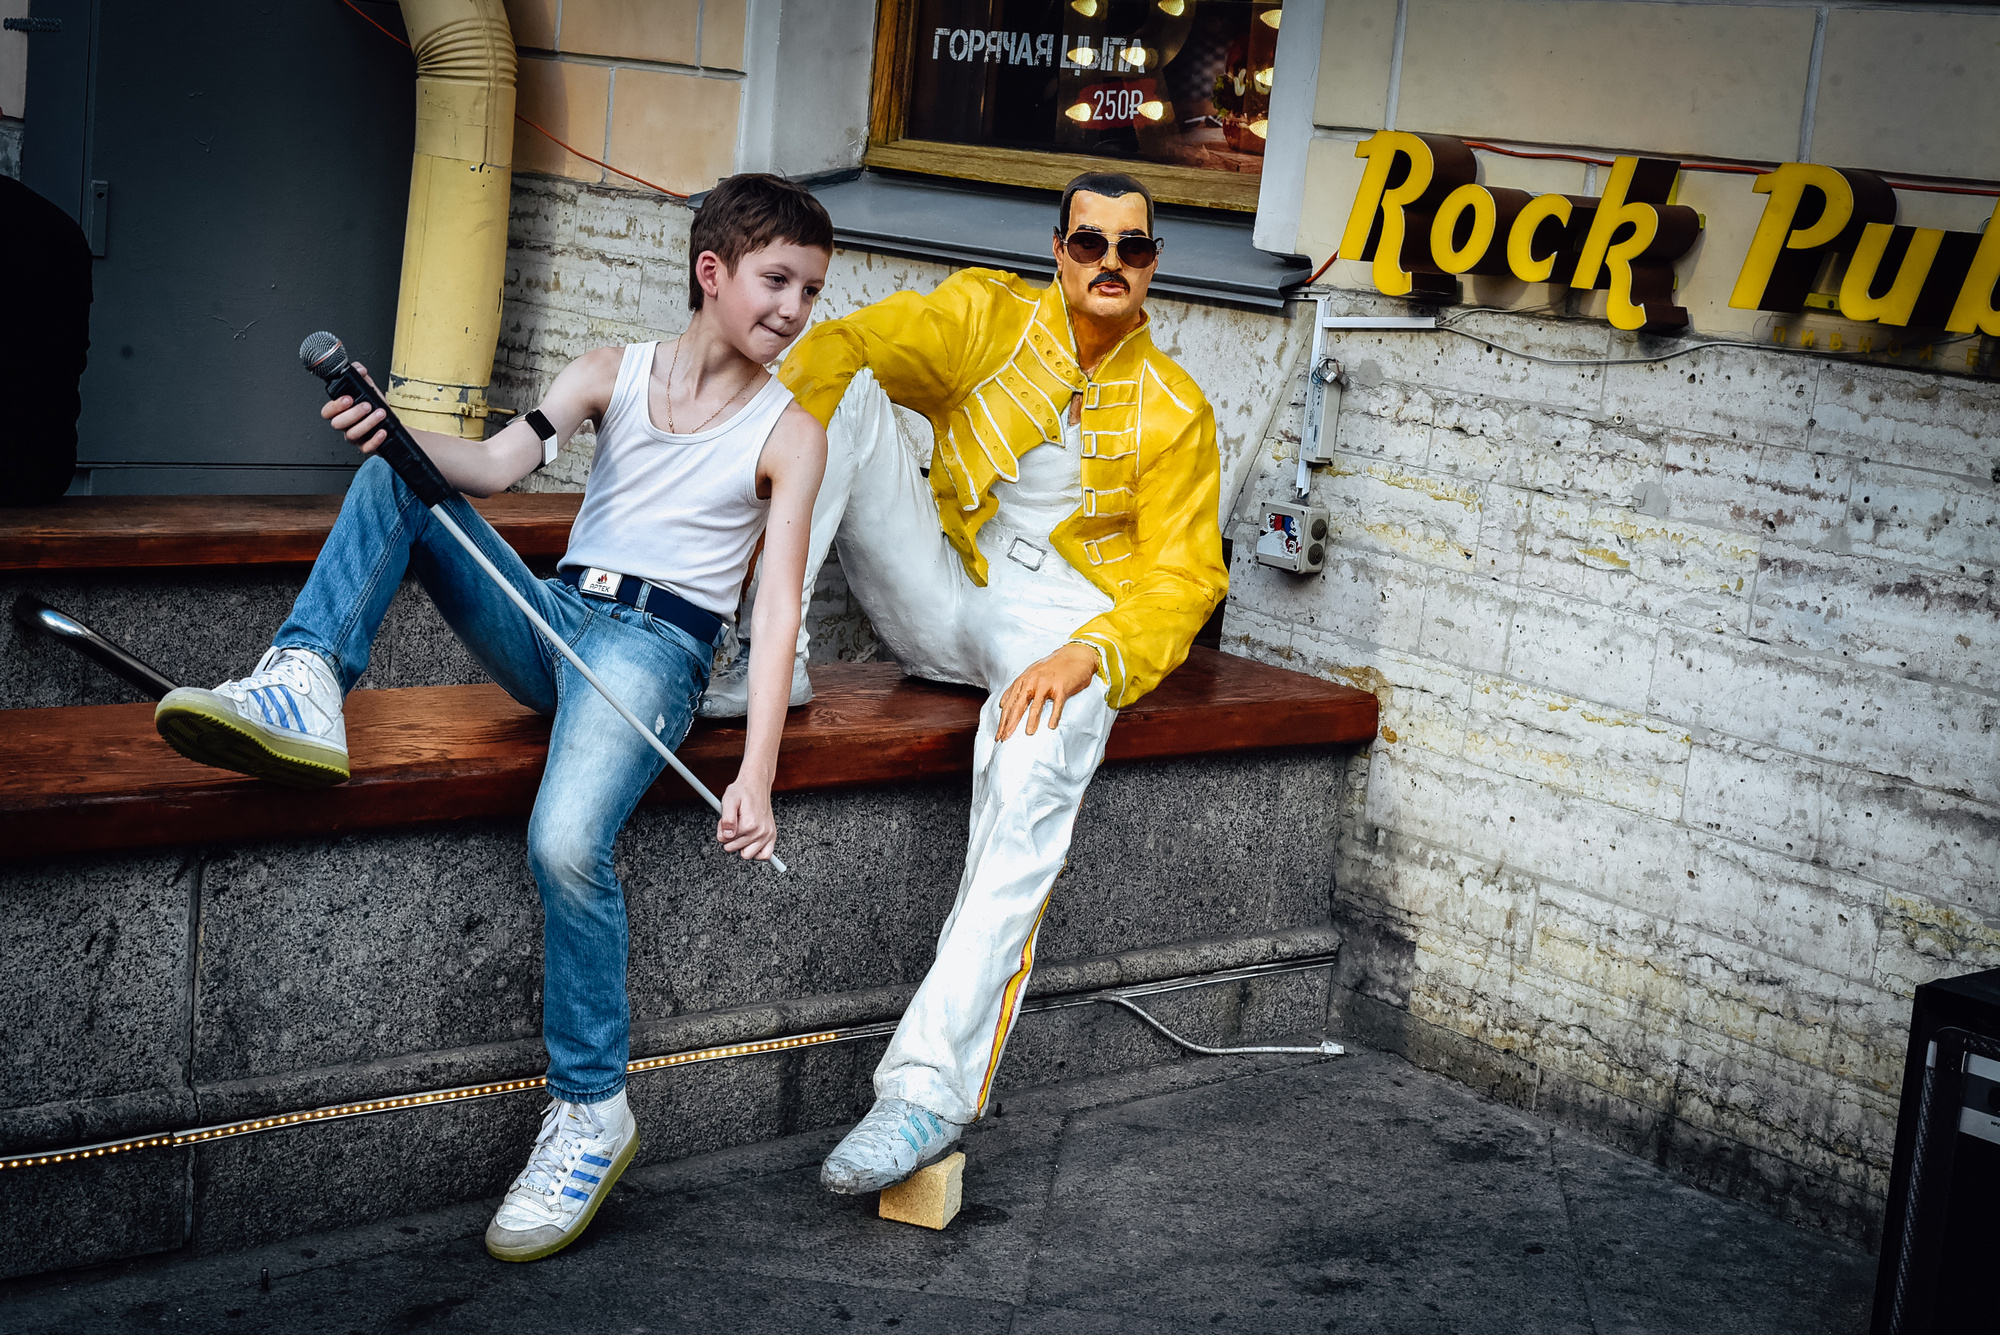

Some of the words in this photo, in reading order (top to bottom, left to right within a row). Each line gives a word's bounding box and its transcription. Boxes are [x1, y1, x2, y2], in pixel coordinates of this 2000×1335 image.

[932, 27, 1054, 67] ГОРЯЧАЯ
[1059, 34, 1146, 76] ЦЫПА
[1338, 130, 1659, 331] Rock
